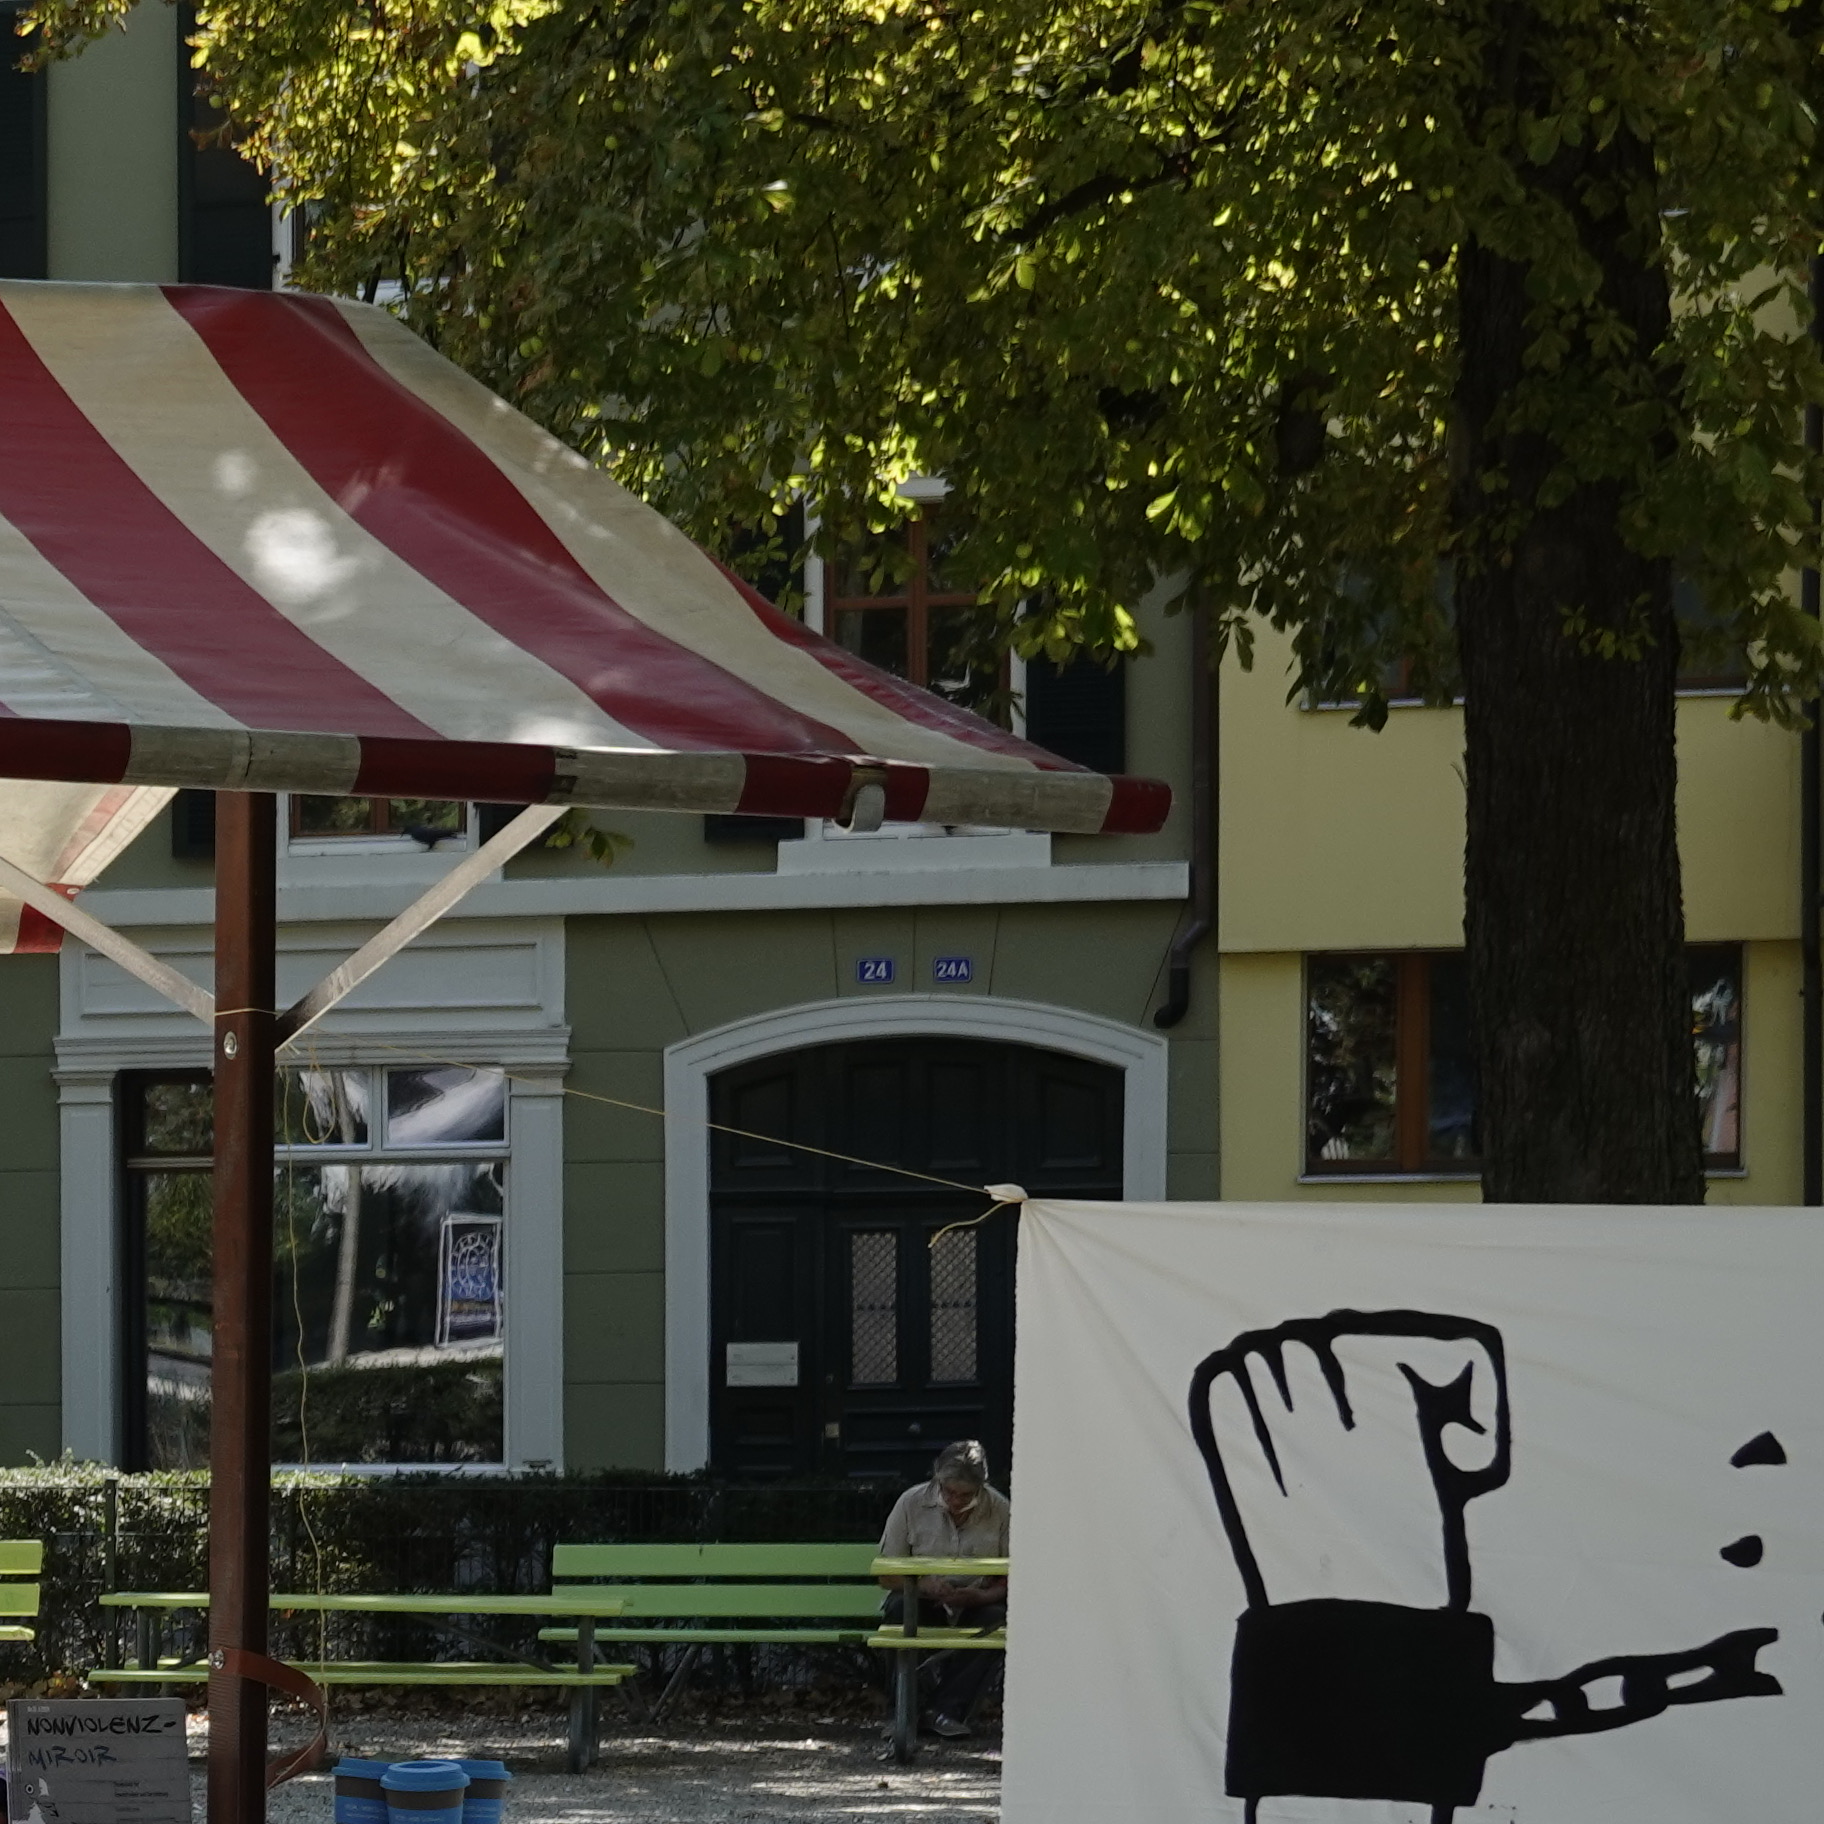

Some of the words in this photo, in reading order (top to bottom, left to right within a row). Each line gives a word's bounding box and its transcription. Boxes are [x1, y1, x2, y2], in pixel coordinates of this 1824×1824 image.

[863, 960, 887, 980] 24
[937, 961, 969, 978] 24A
[28, 1745, 117, 1771] MIROIR
